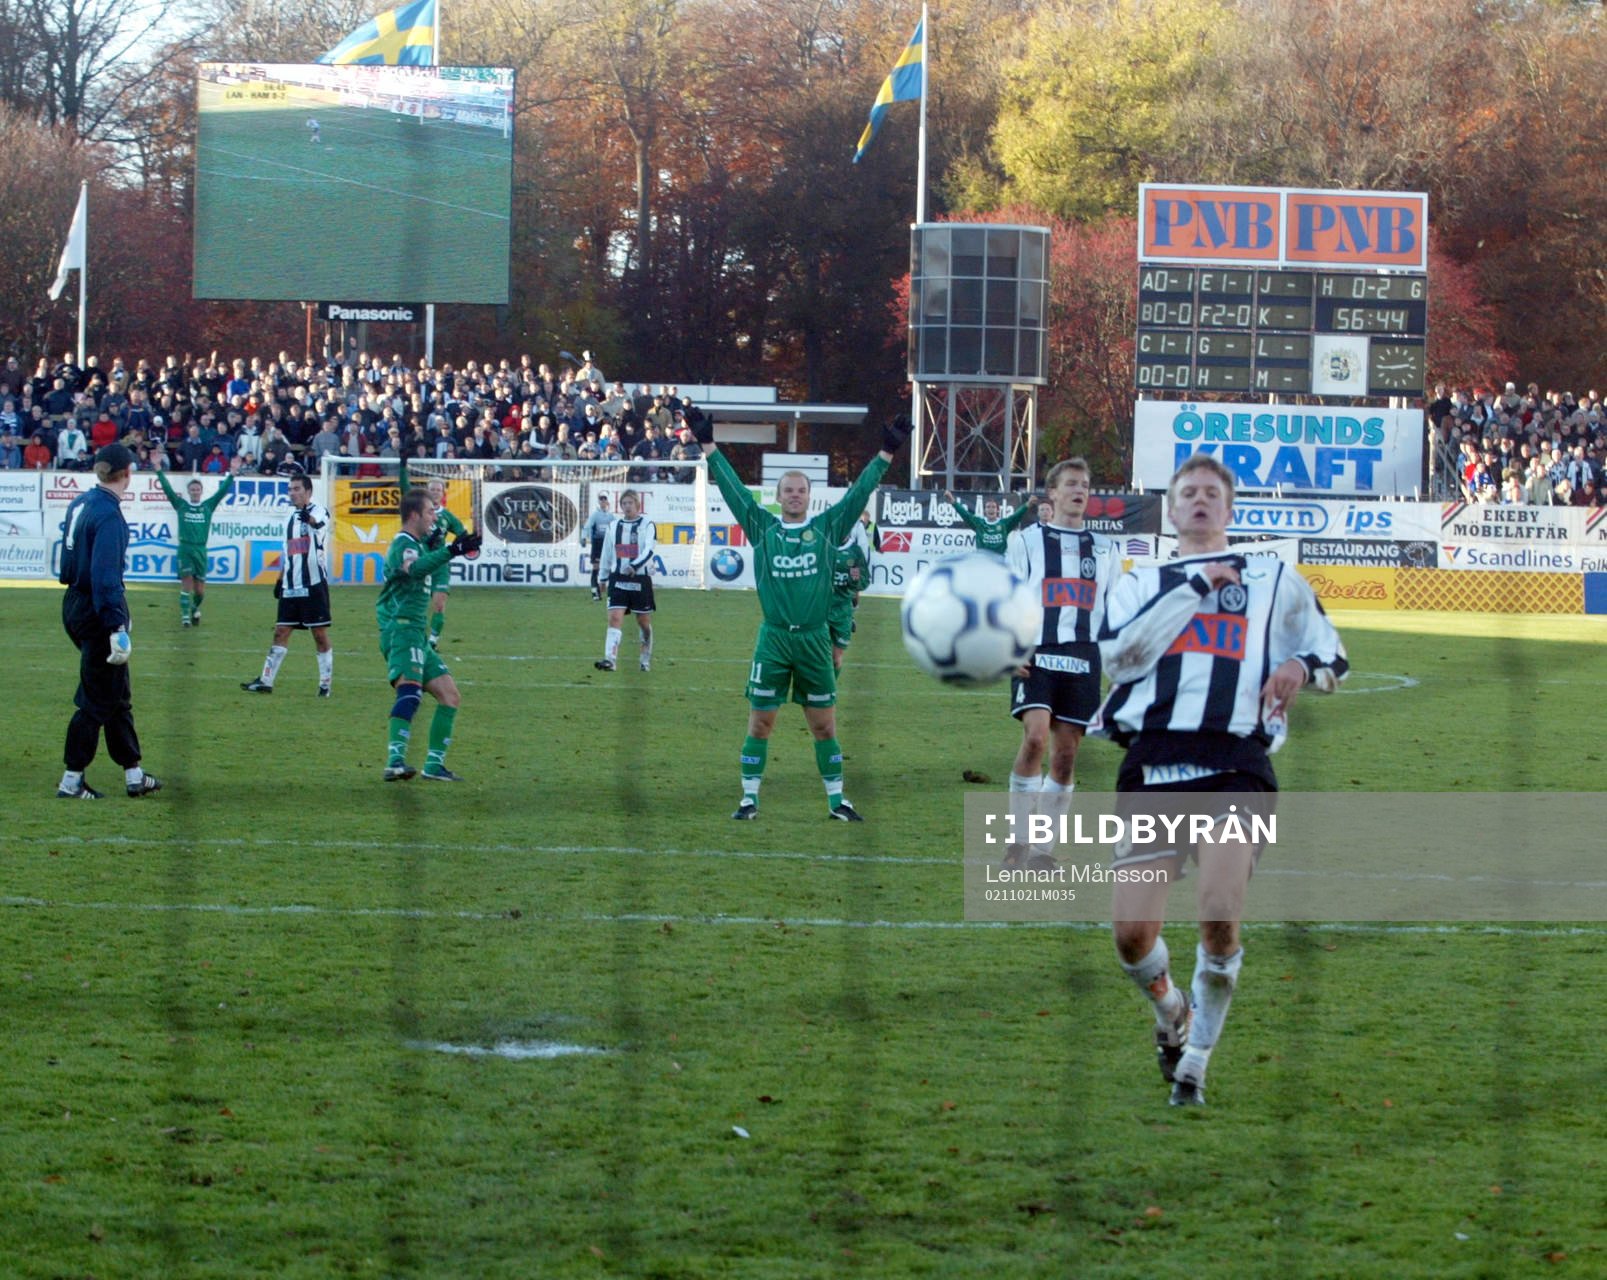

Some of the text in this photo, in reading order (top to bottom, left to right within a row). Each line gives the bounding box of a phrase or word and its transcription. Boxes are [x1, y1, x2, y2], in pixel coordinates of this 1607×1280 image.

[1152, 199, 1274, 249] PNB
[1295, 203, 1416, 255] PNB
[328, 304, 413, 320] Panasonic
[1337, 308, 1404, 330] 56:44
[1173, 404, 1385, 446] ÖRESUNDS
[54, 476, 79, 489] ICA
[221, 493, 291, 513] KPMG
[352, 490, 400, 506] OHLSS
[1083, 520, 1124, 531] URITAS
[1345, 505, 1392, 533] ips
[1483, 509, 1540, 523] EKEBY
[922, 533, 976, 547] BYGGN
[1453, 521, 1568, 540] MÖBELAFFÄR
[1302, 542, 1400, 557] RESTAURANG
[1467, 548, 1573, 568] Scandlines
[773, 552, 816, 568] coop
[1308, 574, 1388, 600] Cloetta
[1185, 618, 1243, 652] NB
[1038, 655, 1088, 673] ATKINS
